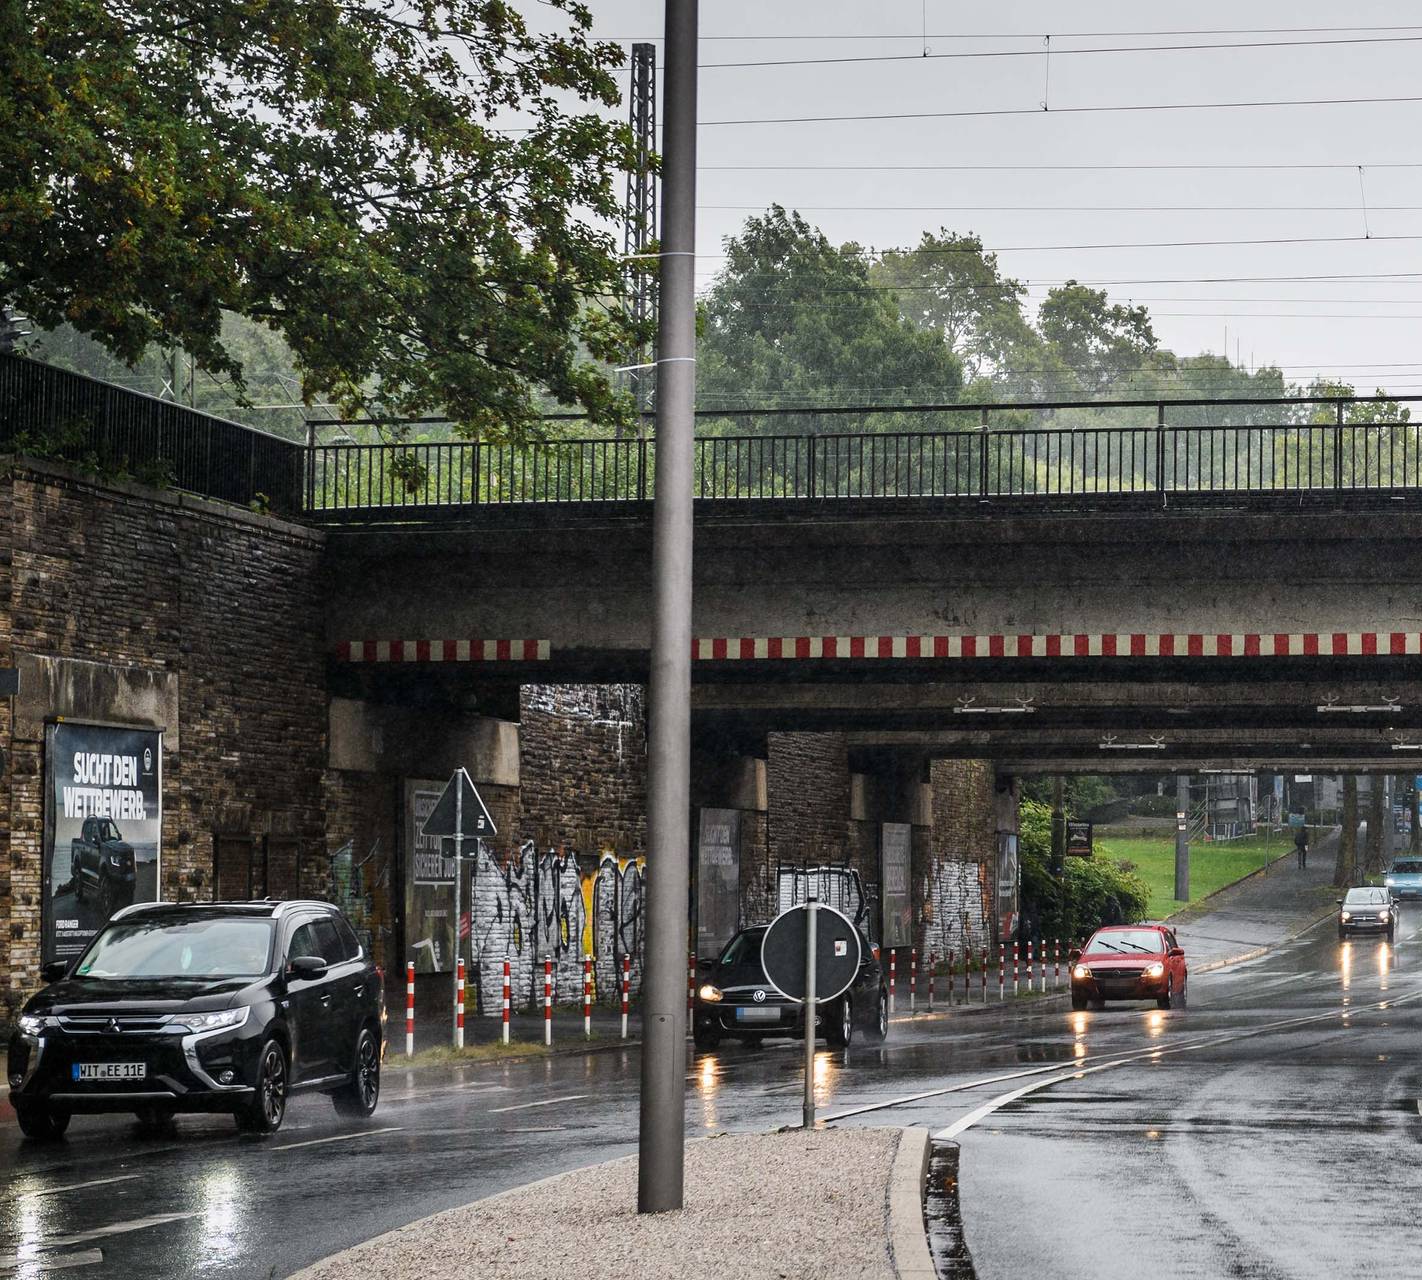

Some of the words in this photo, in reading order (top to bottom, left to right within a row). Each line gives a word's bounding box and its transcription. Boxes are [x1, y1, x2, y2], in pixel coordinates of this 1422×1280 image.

[73, 751, 112, 785] SUCHT
[113, 755, 138, 787] DEN
[63, 786, 147, 821] WETTBEWERB.
[80, 1065, 99, 1077] WIT
[107, 1065, 121, 1077] EE
[123, 1064, 144, 1077] 11E
